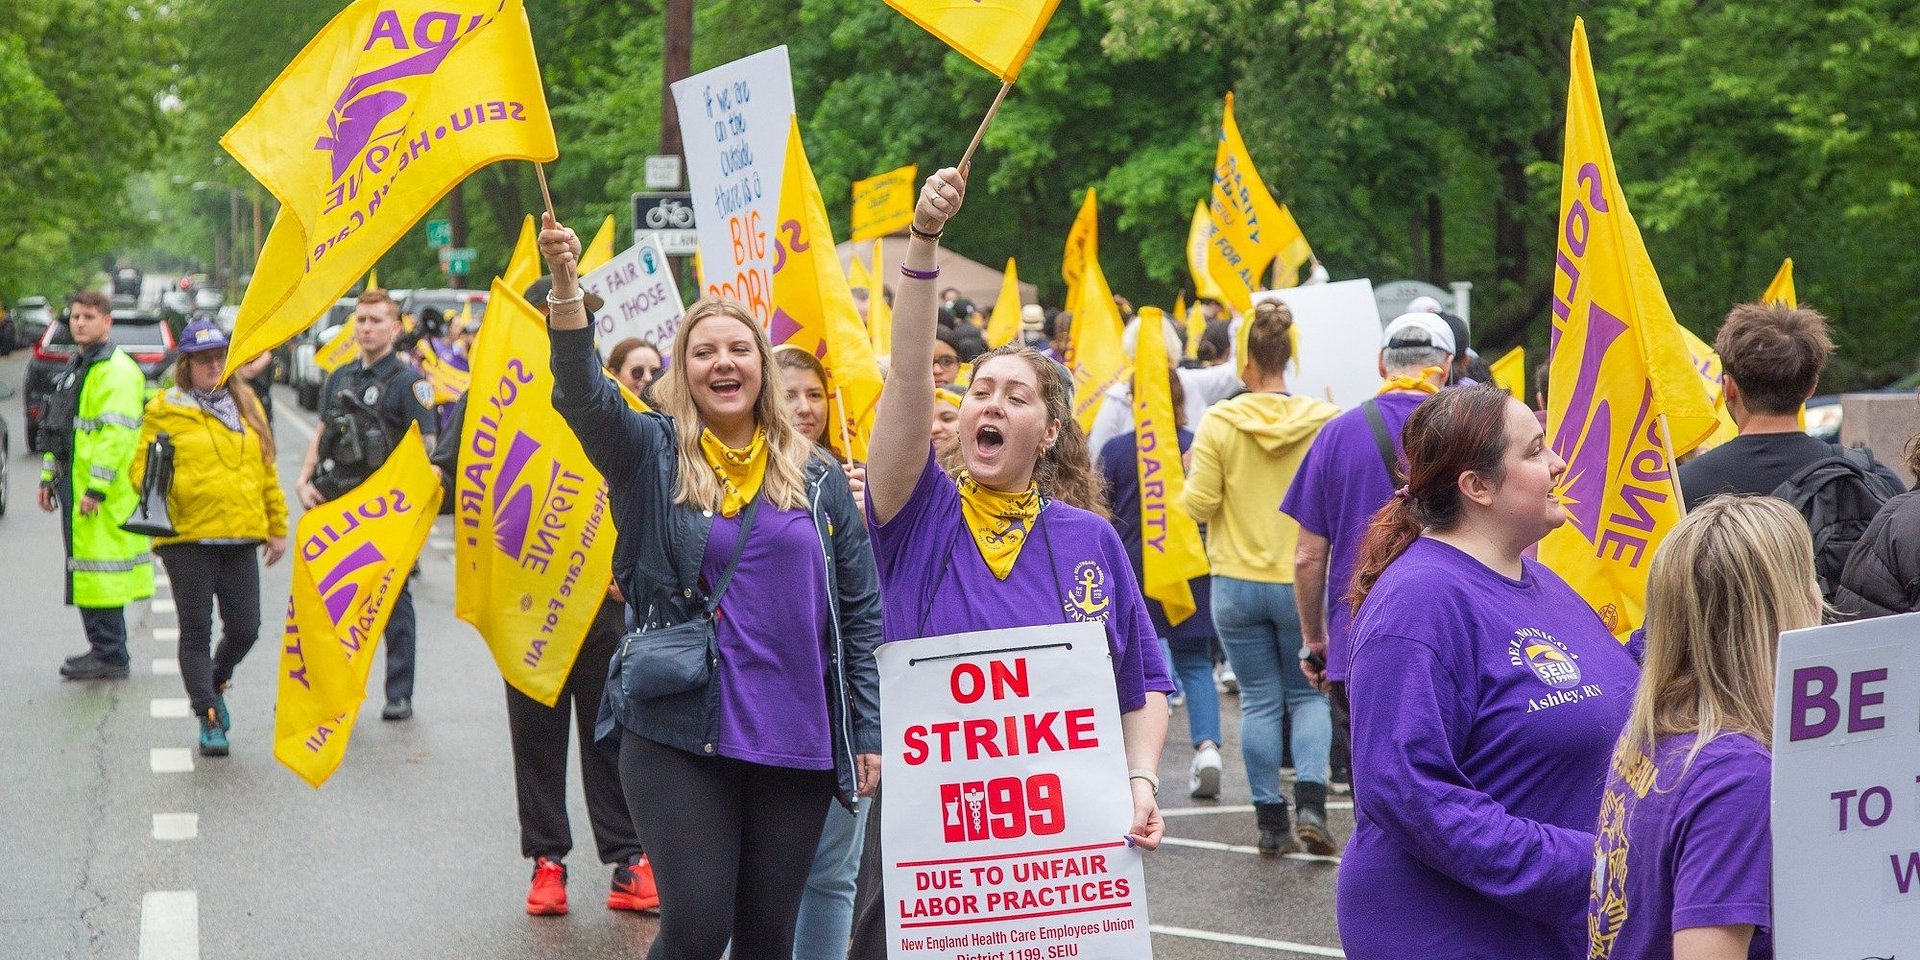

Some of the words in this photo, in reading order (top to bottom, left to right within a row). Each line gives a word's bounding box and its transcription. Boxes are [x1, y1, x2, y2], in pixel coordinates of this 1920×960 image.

[716, 88, 731, 112] we
[733, 80, 749, 104] are
[714, 120, 727, 142] on
[729, 112, 745, 136] the
[720, 140, 753, 177] outside
[714, 182, 741, 220] there
[742, 177, 752, 203] is
[729, 210, 766, 266] BIG
[605, 263, 638, 293] FAIR
[620, 283, 666, 321] THOSE
[950, 657, 1030, 704] ON
[1538, 661, 1575, 679] SEIU
[1545, 672, 1579, 686] 1199NE
[1527, 689, 1584, 713] Ashley,
[1581, 684, 1603, 698] RN
[1790, 666, 1888, 742] BE
[903, 707, 1099, 766] STRIKE
[940, 773, 1066, 843] 1199
[1830, 785, 1893, 831] TO
[916, 870, 963, 892] DUE
[970, 866, 1004, 888] TO
[1013, 854, 1107, 883] UNFAIR
[900, 895, 979, 919] LABOR
[987, 878, 1130, 913] PRACTICES
[901, 938, 923, 952] New
[927, 933, 968, 952] England
[971, 930, 1007, 948] Health
[1010, 928, 1036, 944] Care
[1040, 924, 1099, 943] Employees
[1103, 918, 1134, 933] Union
[1048, 943, 1078, 958] SEIU
